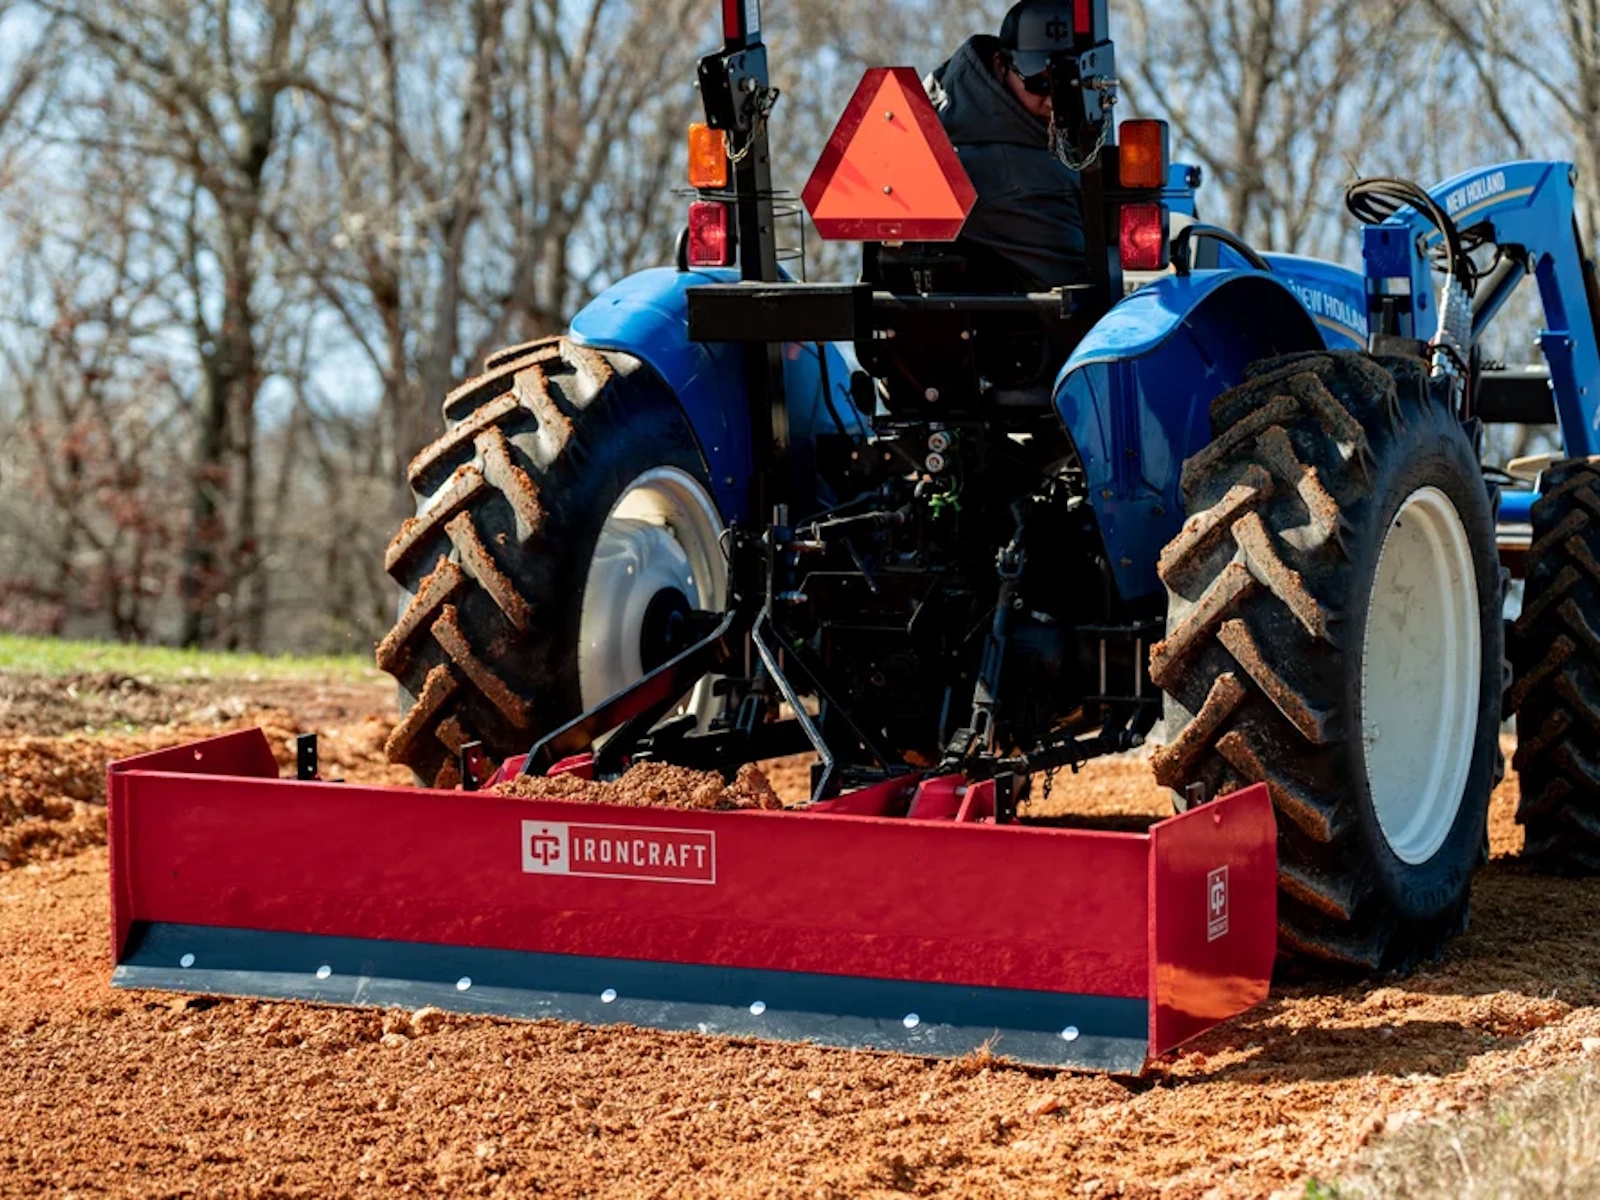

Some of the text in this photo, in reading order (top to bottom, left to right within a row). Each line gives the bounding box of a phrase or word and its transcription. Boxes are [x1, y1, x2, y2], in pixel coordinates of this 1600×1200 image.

[1445, 171, 1506, 217] NEW HOLLAND
[1322, 293, 1368, 339] HOLLAN
[573, 837, 706, 869] IRONCRAFT
